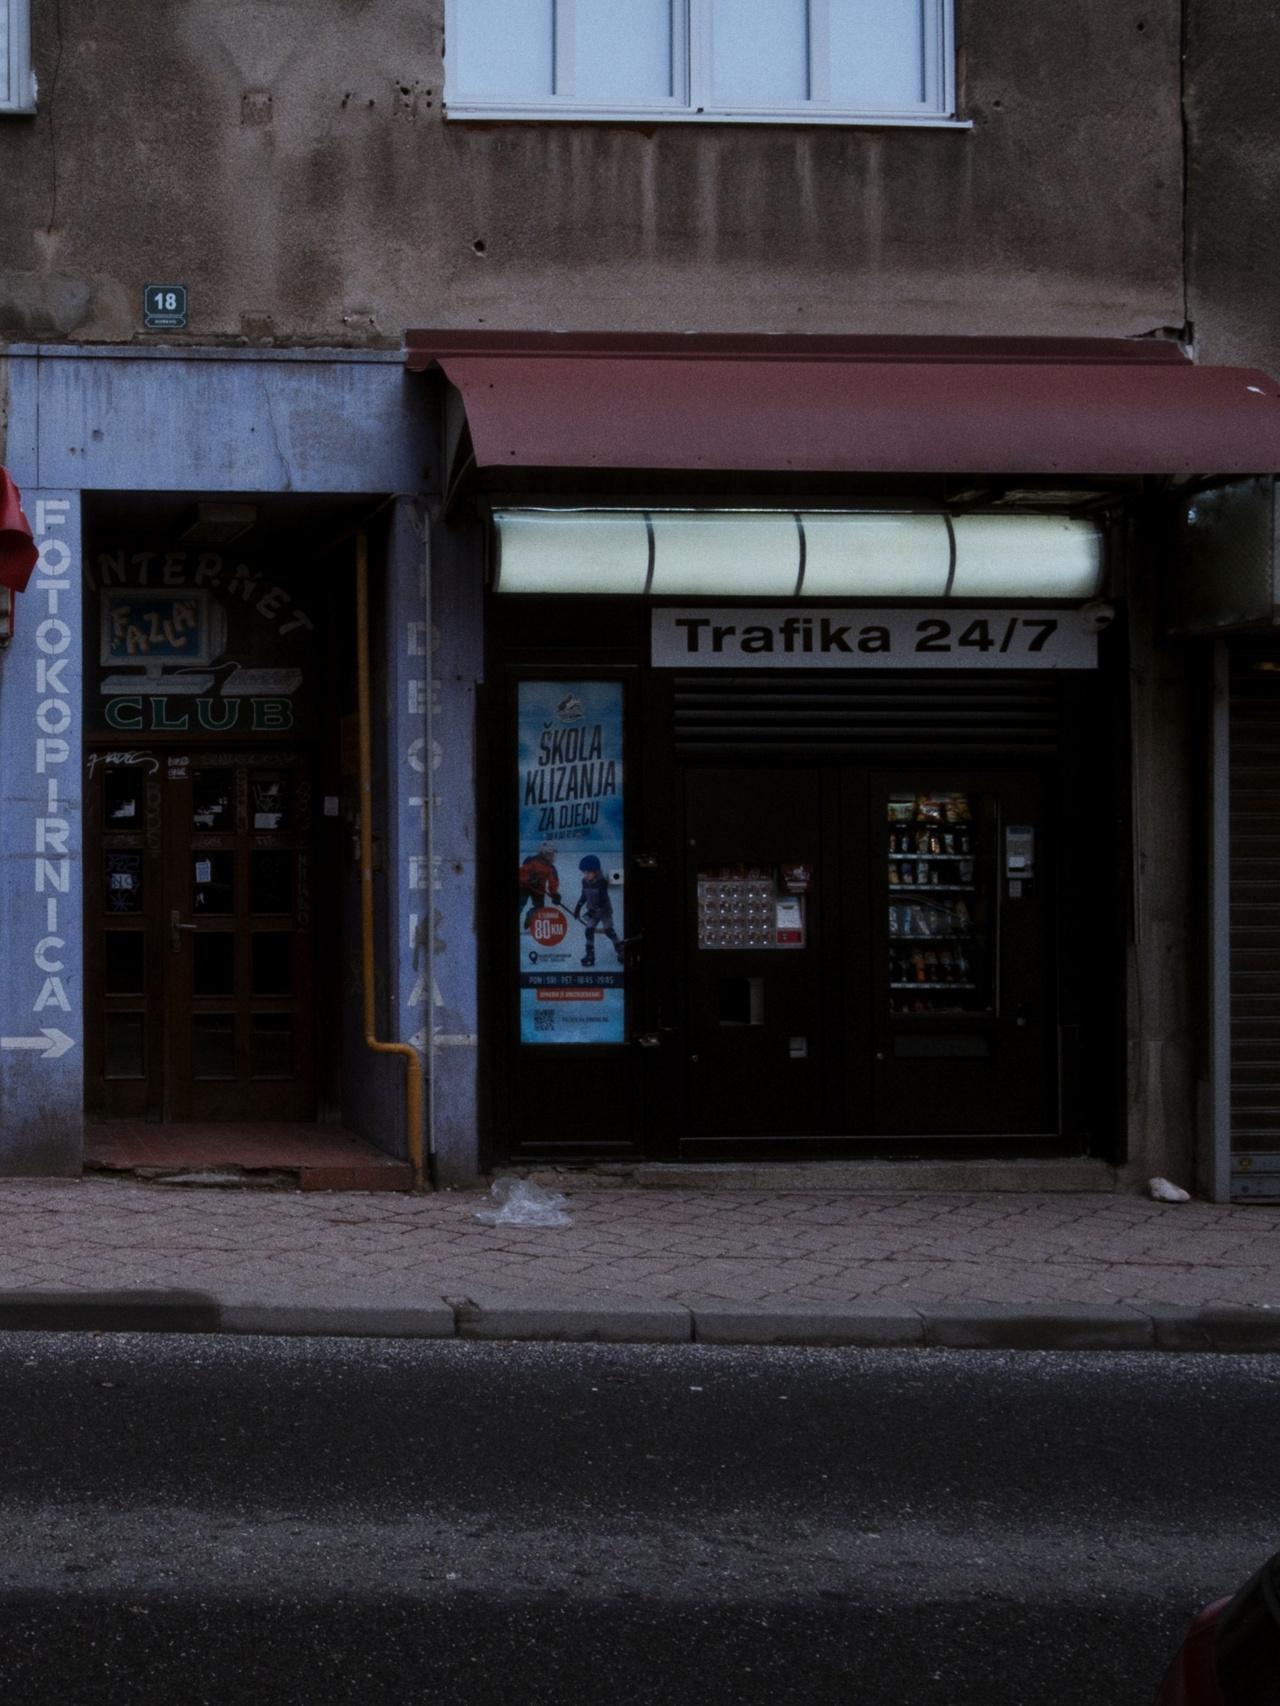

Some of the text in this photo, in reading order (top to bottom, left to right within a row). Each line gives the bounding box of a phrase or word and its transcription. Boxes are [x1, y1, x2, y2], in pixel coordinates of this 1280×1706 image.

[154, 292, 177, 310] 18
[83, 549, 316, 636] INTERNET
[675, 618, 1059, 653] Trafika 24/7
[104, 696, 295, 731] CLUB
[34, 500, 72, 1012] FOTOKOPIRNICA
[538, 721, 602, 767] ŠKOLA
[524, 760, 616, 806] KLIZANJA
[537, 801, 600, 832] ZA DJECU
[535, 920, 564, 939] 80 KM
